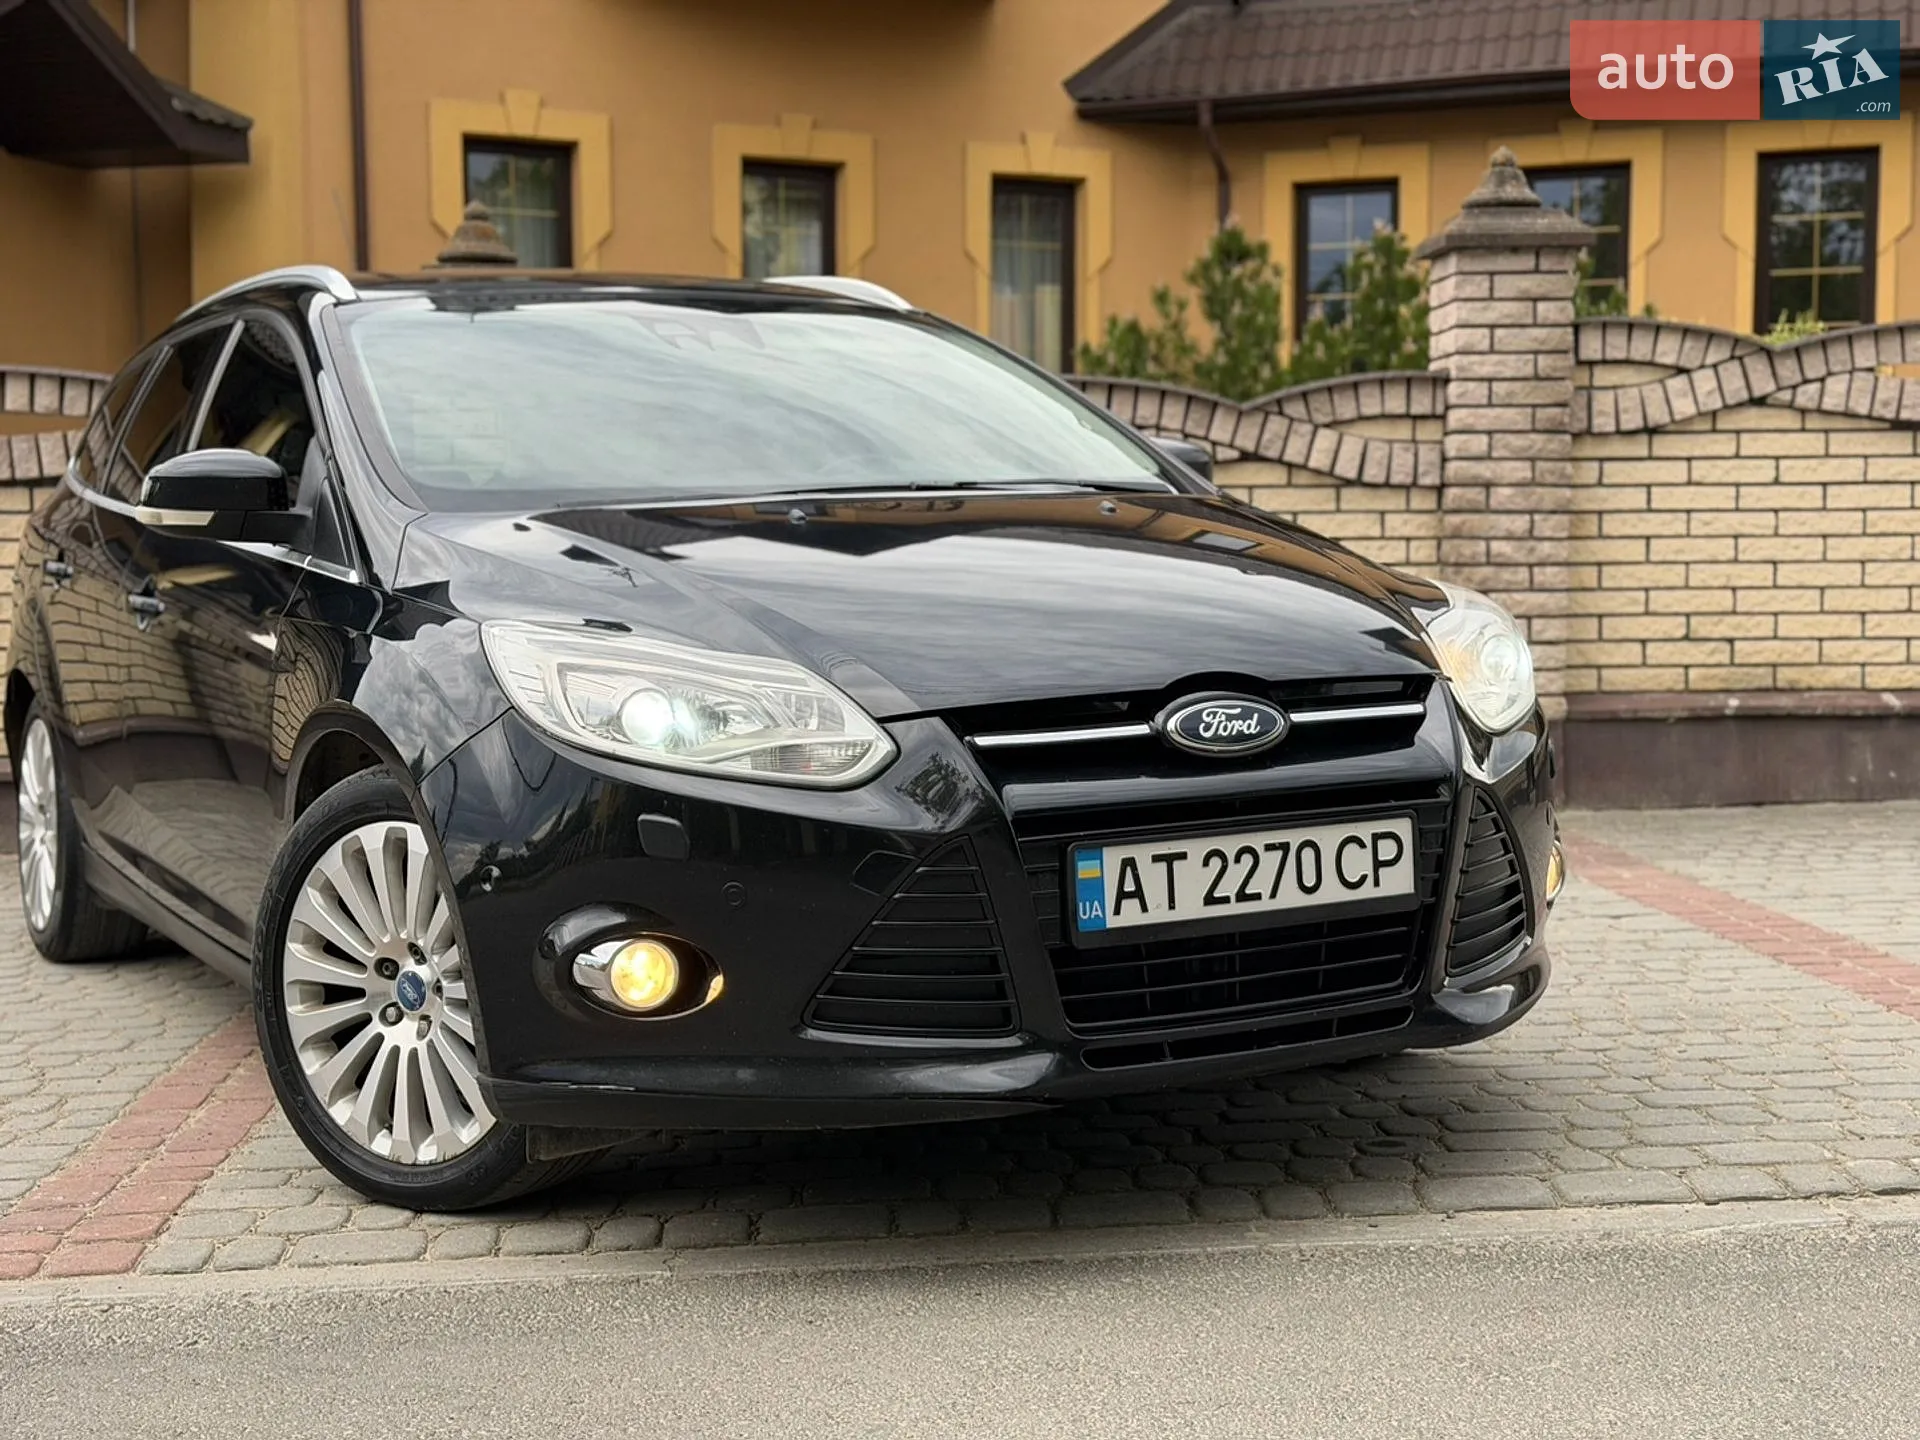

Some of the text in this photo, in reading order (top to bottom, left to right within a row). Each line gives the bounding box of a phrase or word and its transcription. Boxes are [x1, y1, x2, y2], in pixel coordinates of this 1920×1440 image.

[1199, 707, 1260, 738] Ford
[1112, 830, 1404, 916] AT 2270 CP
[1079, 900, 1103, 919] UA
